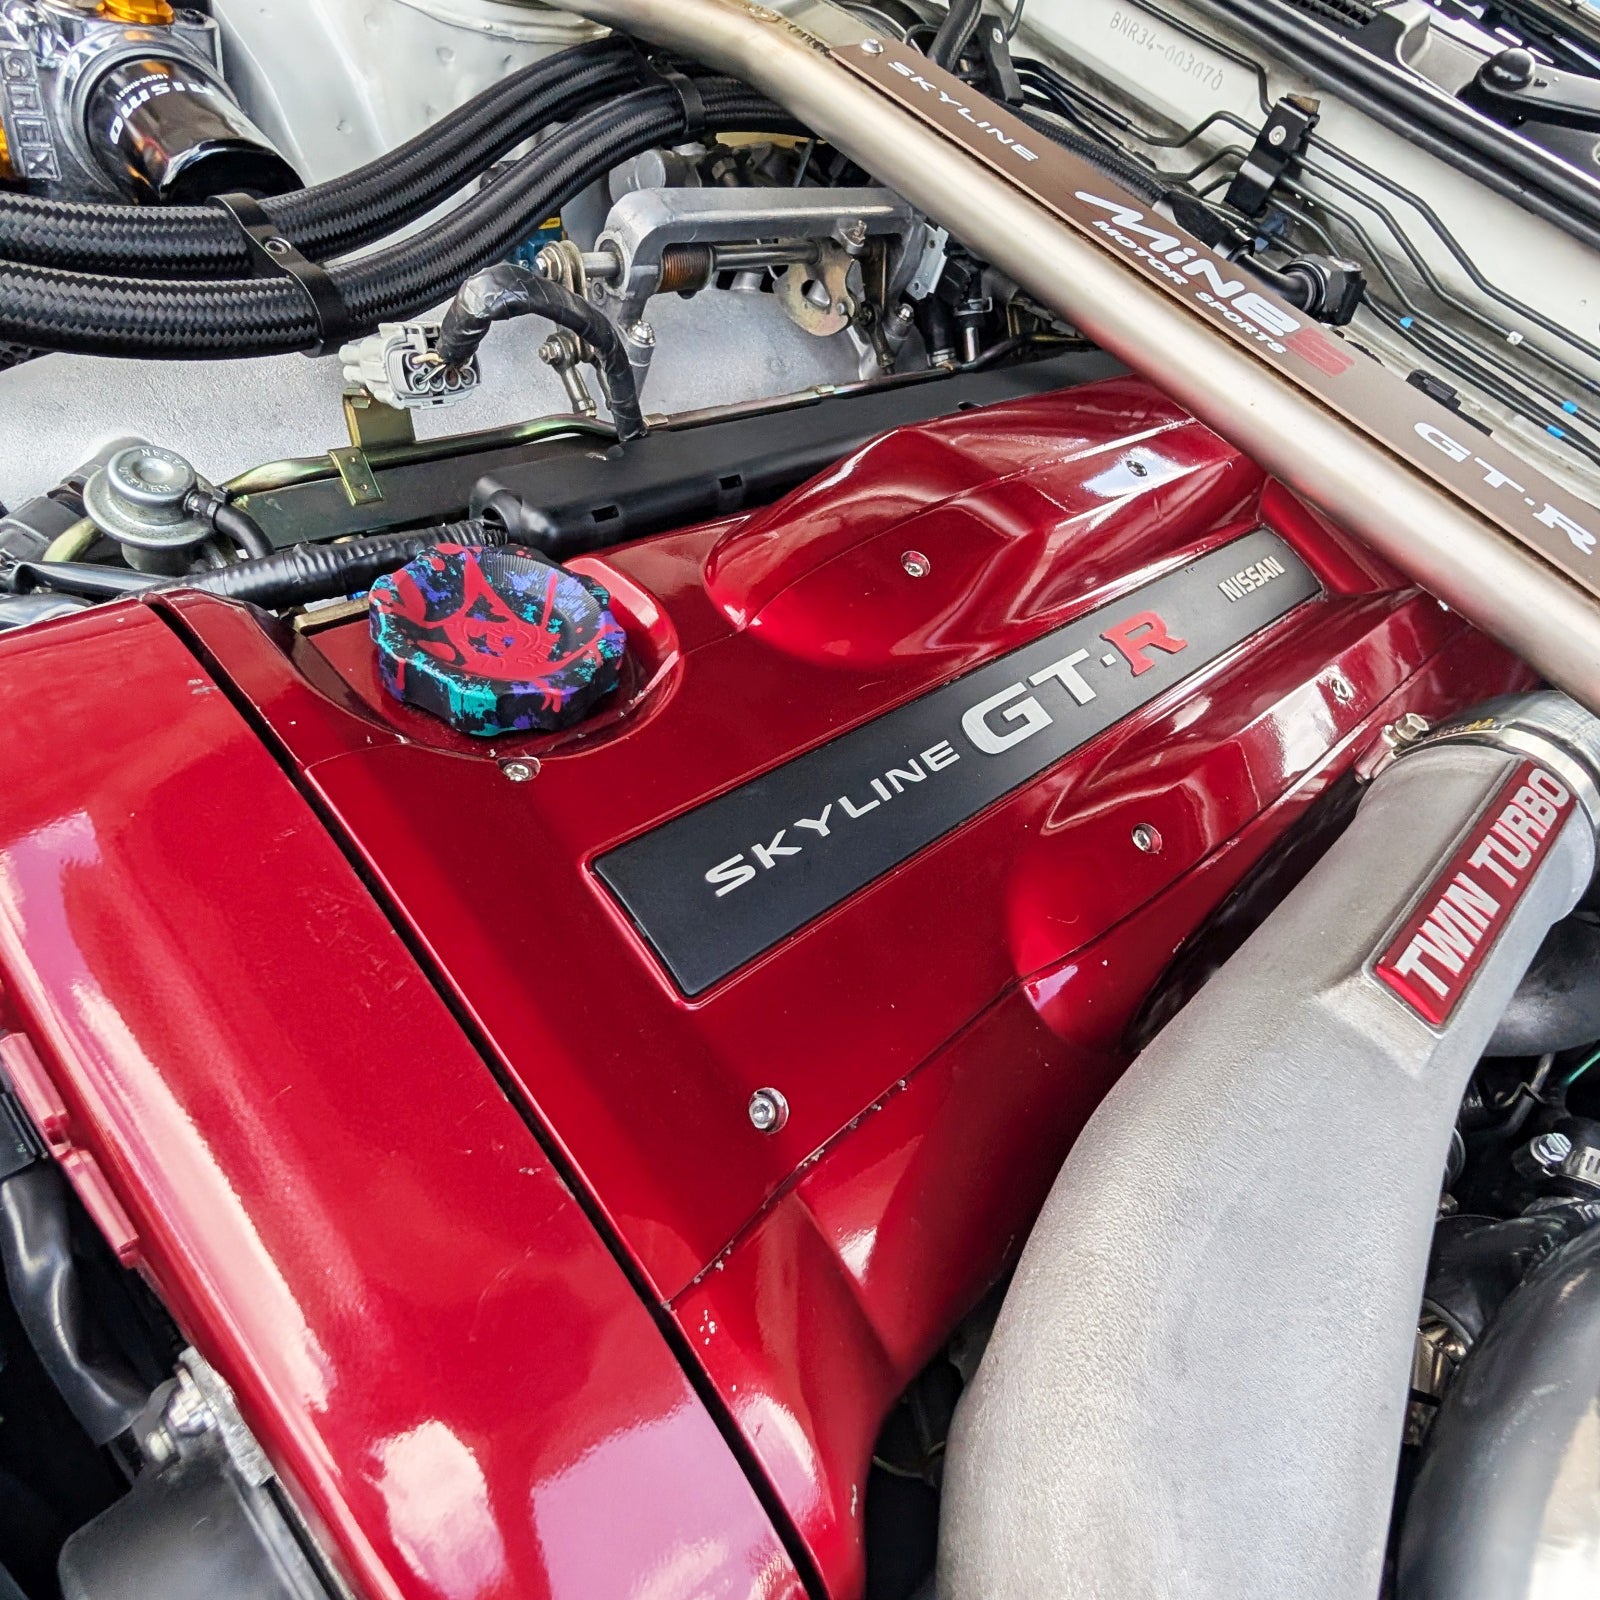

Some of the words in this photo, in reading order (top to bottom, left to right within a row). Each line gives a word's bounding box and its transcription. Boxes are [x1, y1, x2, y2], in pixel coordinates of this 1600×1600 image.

[109, 81, 215, 145] nismo
[887, 61, 1039, 162] SKYLINE
[1110, 11, 1223, 91] BNR34-003070
[3, 52, 58, 178] GREX
[1092, 220, 1189, 285] MOTOR
[1195, 291, 1287, 354] SPORTS
[704, 740, 961, 898] SKYLINE
[1218, 556, 1286, 603] NISSAN
[1395, 871, 1500, 998] TWIN
[1469, 767, 1571, 888] TURBO
